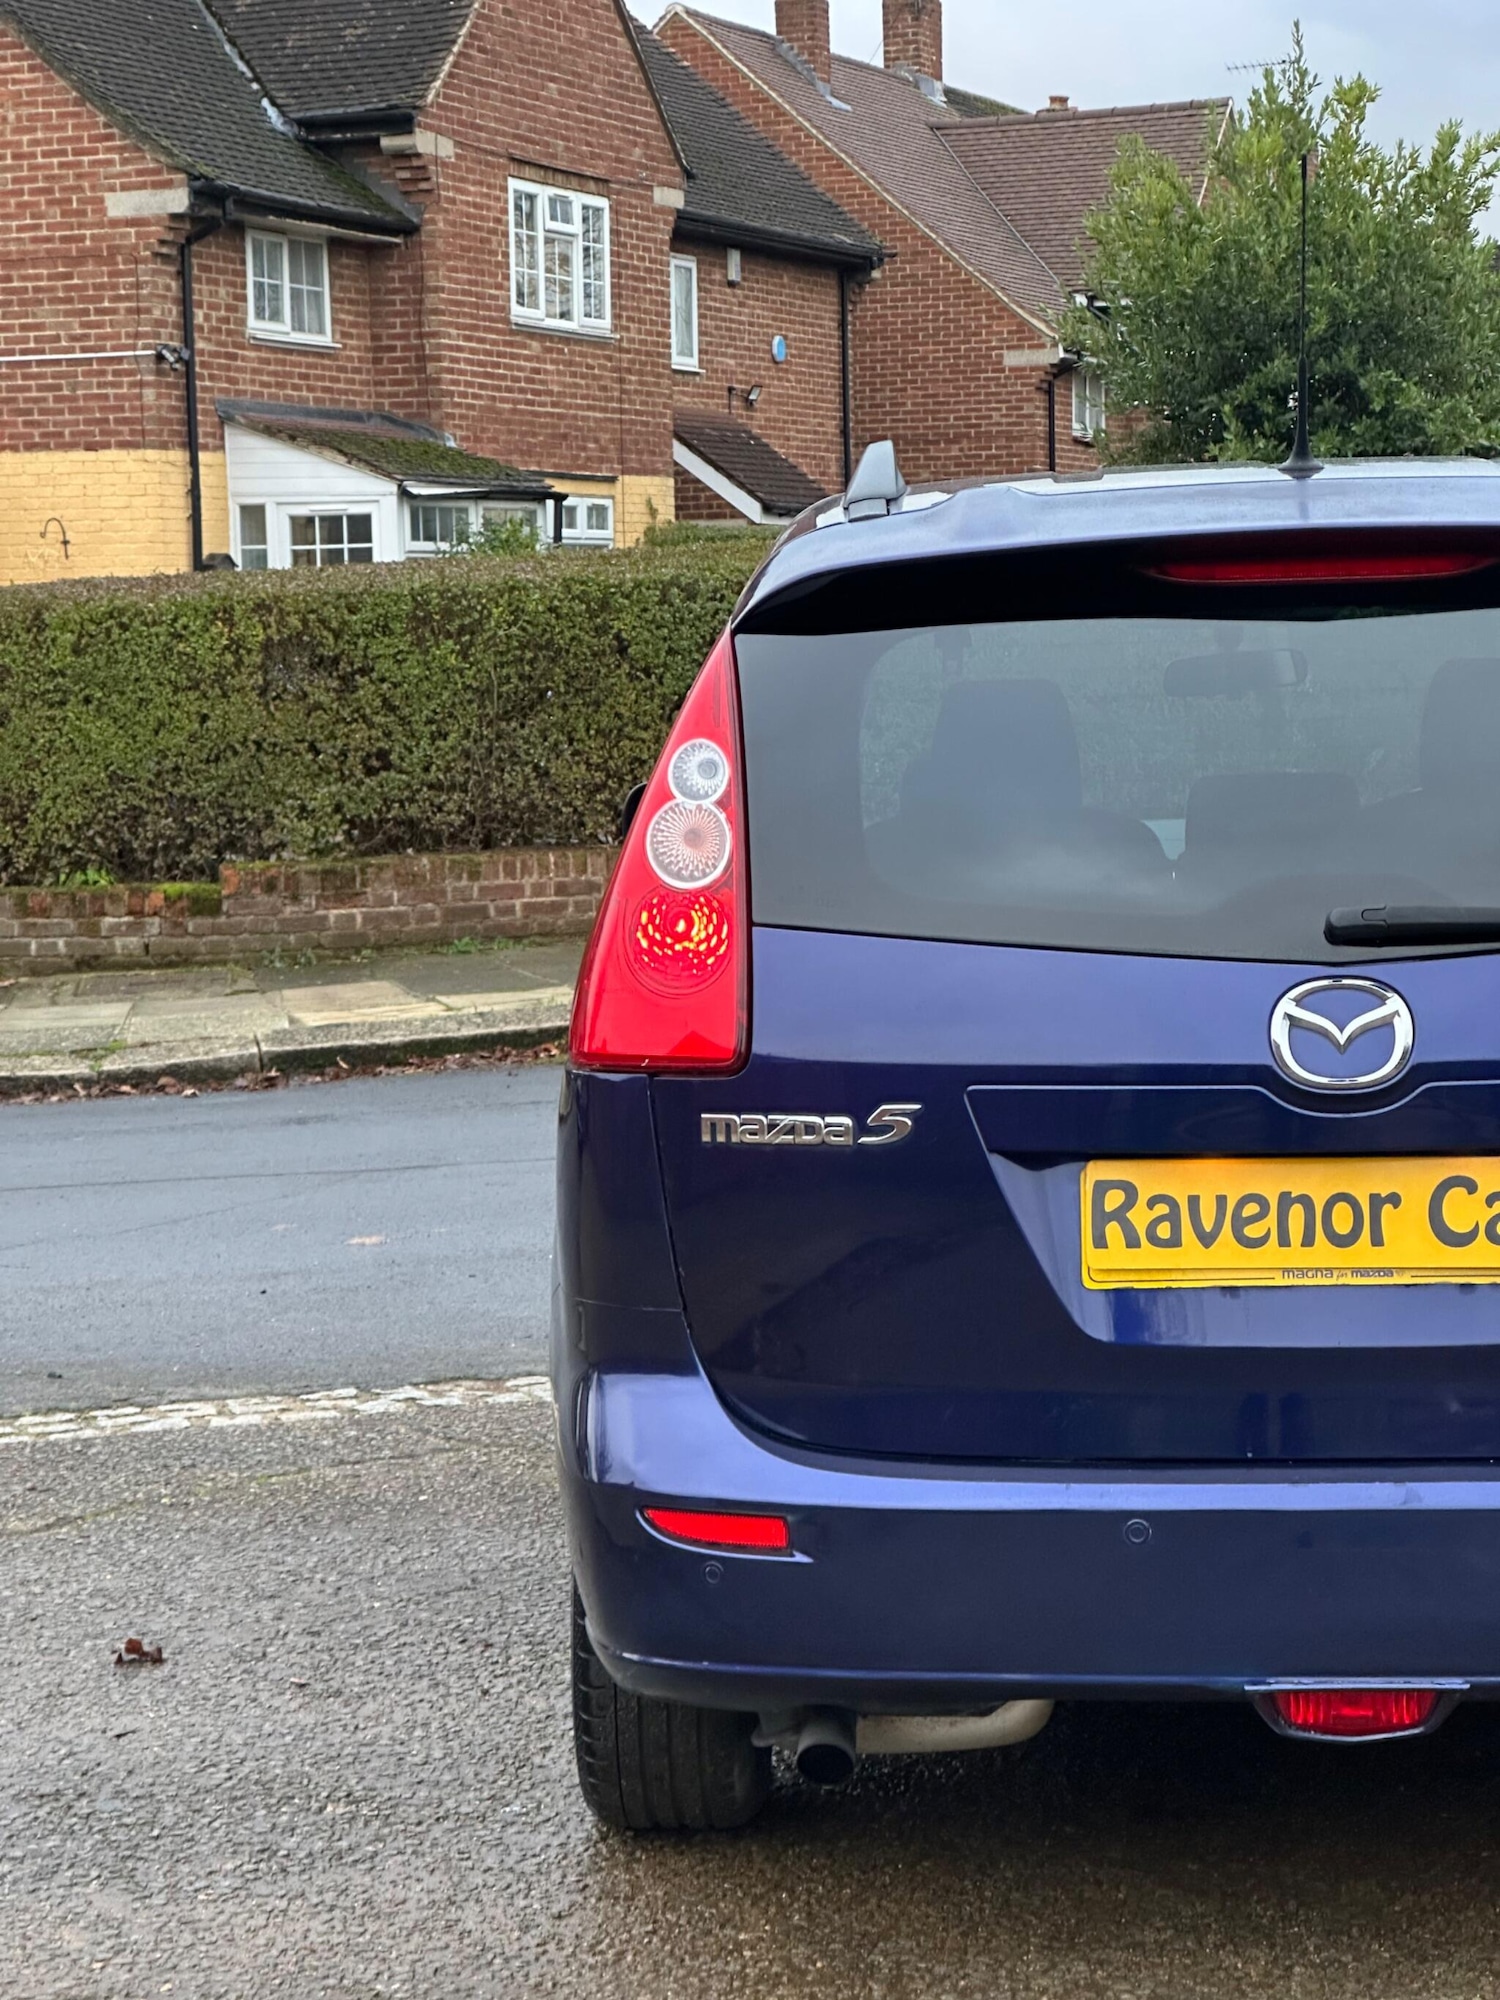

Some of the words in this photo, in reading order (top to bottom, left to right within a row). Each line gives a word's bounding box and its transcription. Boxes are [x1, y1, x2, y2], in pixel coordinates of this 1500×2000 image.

[701, 1114, 853, 1145] mazda
[857, 1104, 922, 1144] 5
[1091, 1179, 1402, 1249] Ravenor
